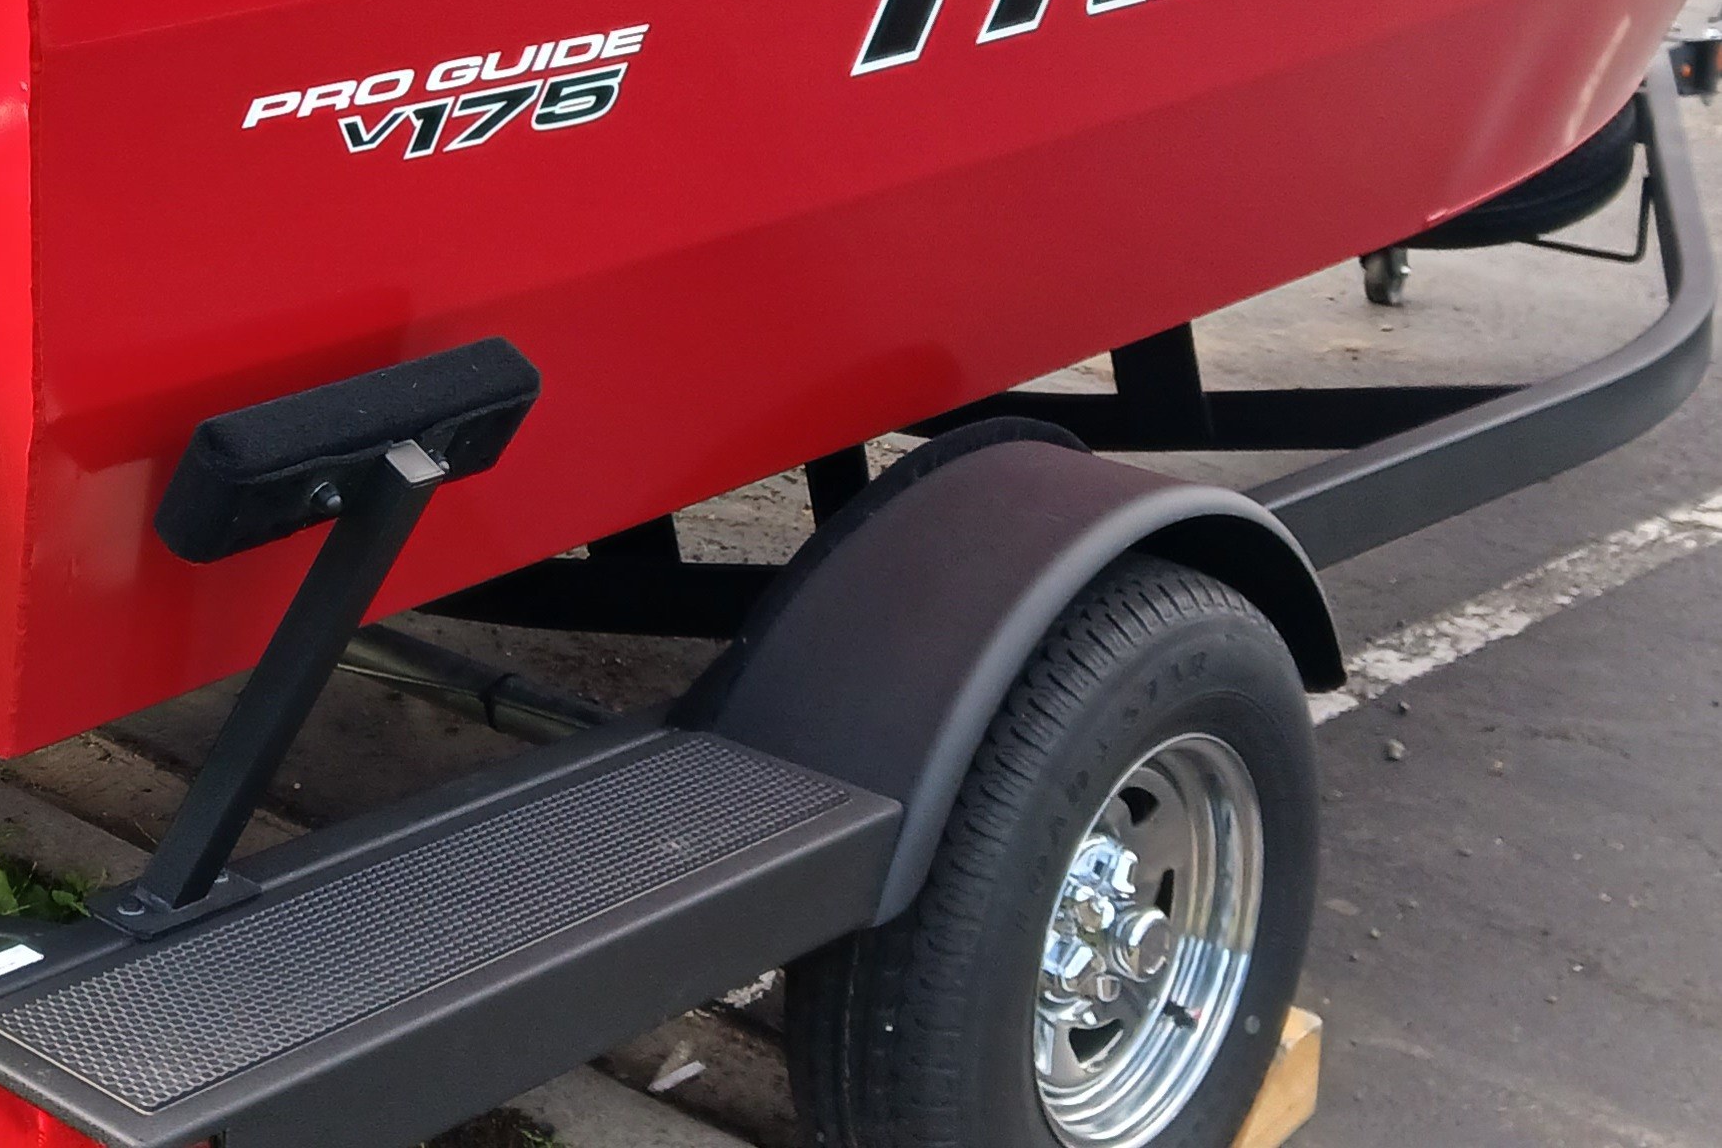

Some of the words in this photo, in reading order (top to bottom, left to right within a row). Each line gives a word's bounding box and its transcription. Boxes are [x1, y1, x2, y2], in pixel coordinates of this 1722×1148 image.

[241, 68, 416, 129] PRO
[424, 23, 650, 92] GUIDE
[337, 62, 629, 161] V175
